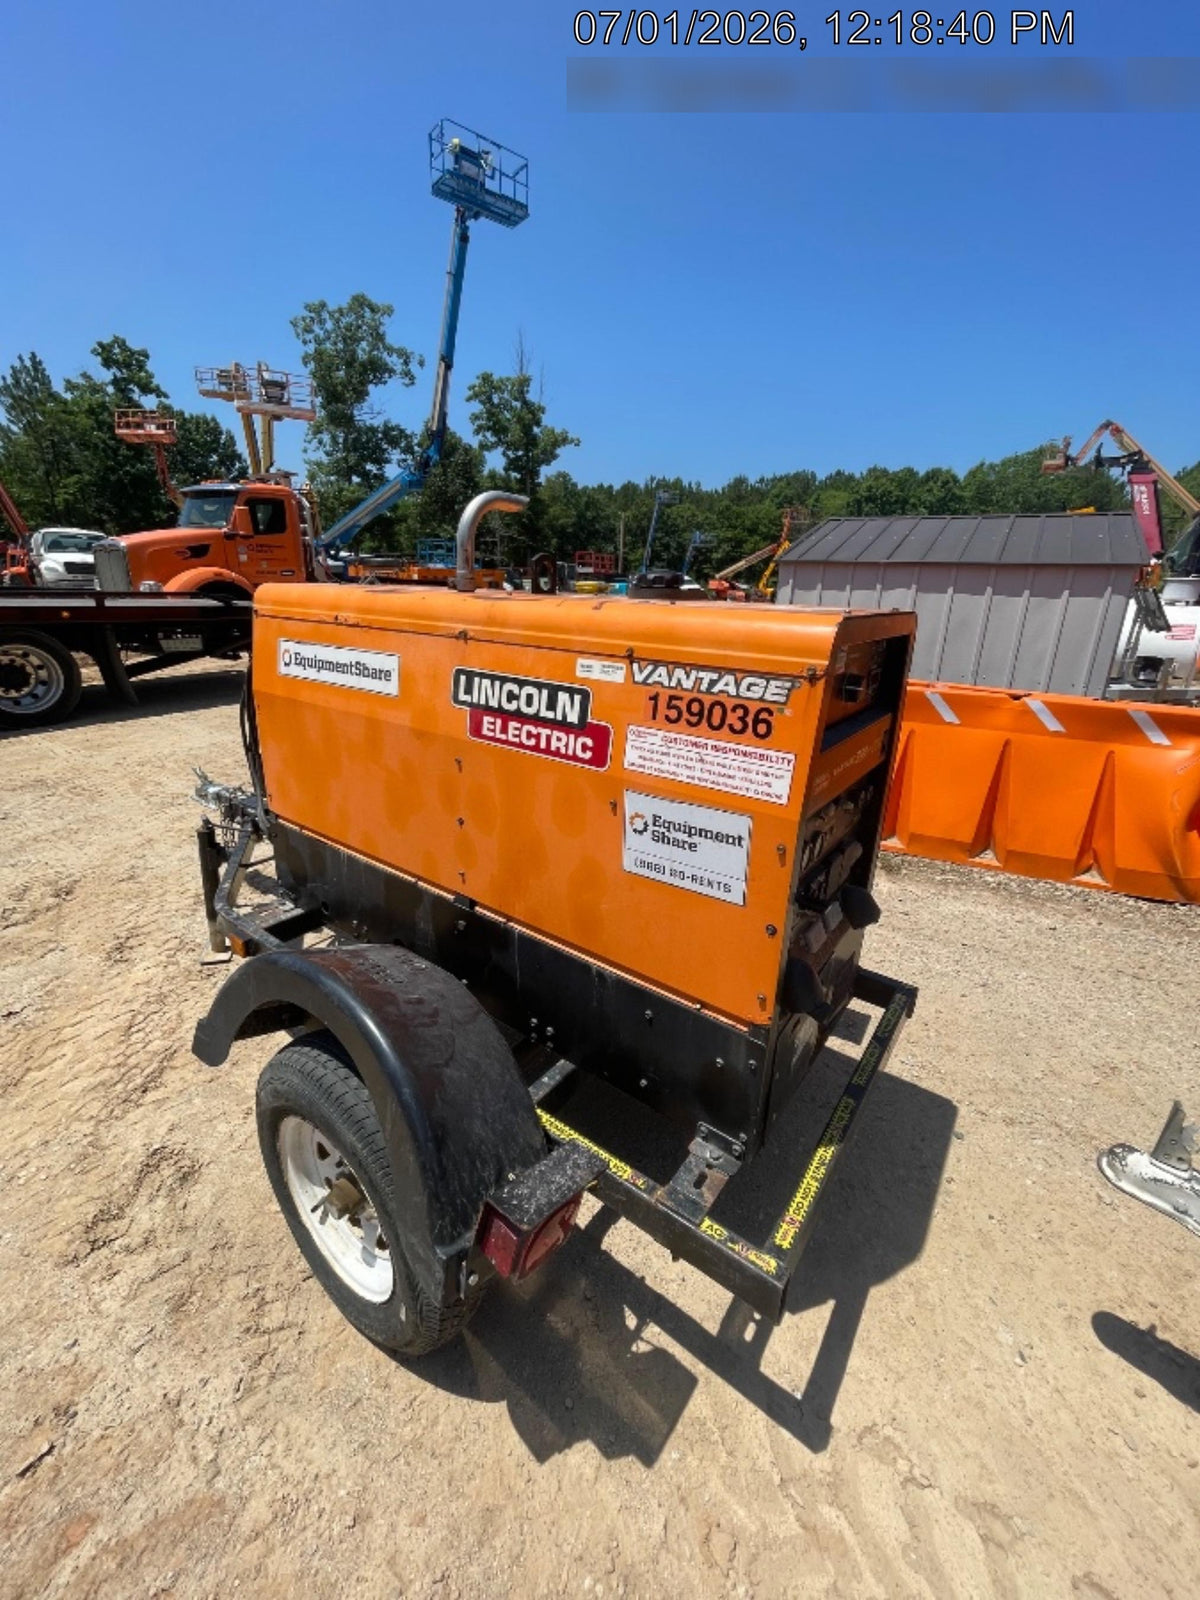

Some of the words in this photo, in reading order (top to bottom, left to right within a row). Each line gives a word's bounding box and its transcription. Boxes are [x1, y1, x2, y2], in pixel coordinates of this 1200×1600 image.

[294, 652, 392, 681] EquipmentShare
[632, 661, 792, 703] VANTAGE
[458, 674, 582, 724] LINCOLN
[648, 691, 774, 739] 159036
[482, 715, 593, 760] ELECTRIC
[651, 830, 698, 852] Share
[652, 814, 745, 848] Equipment
